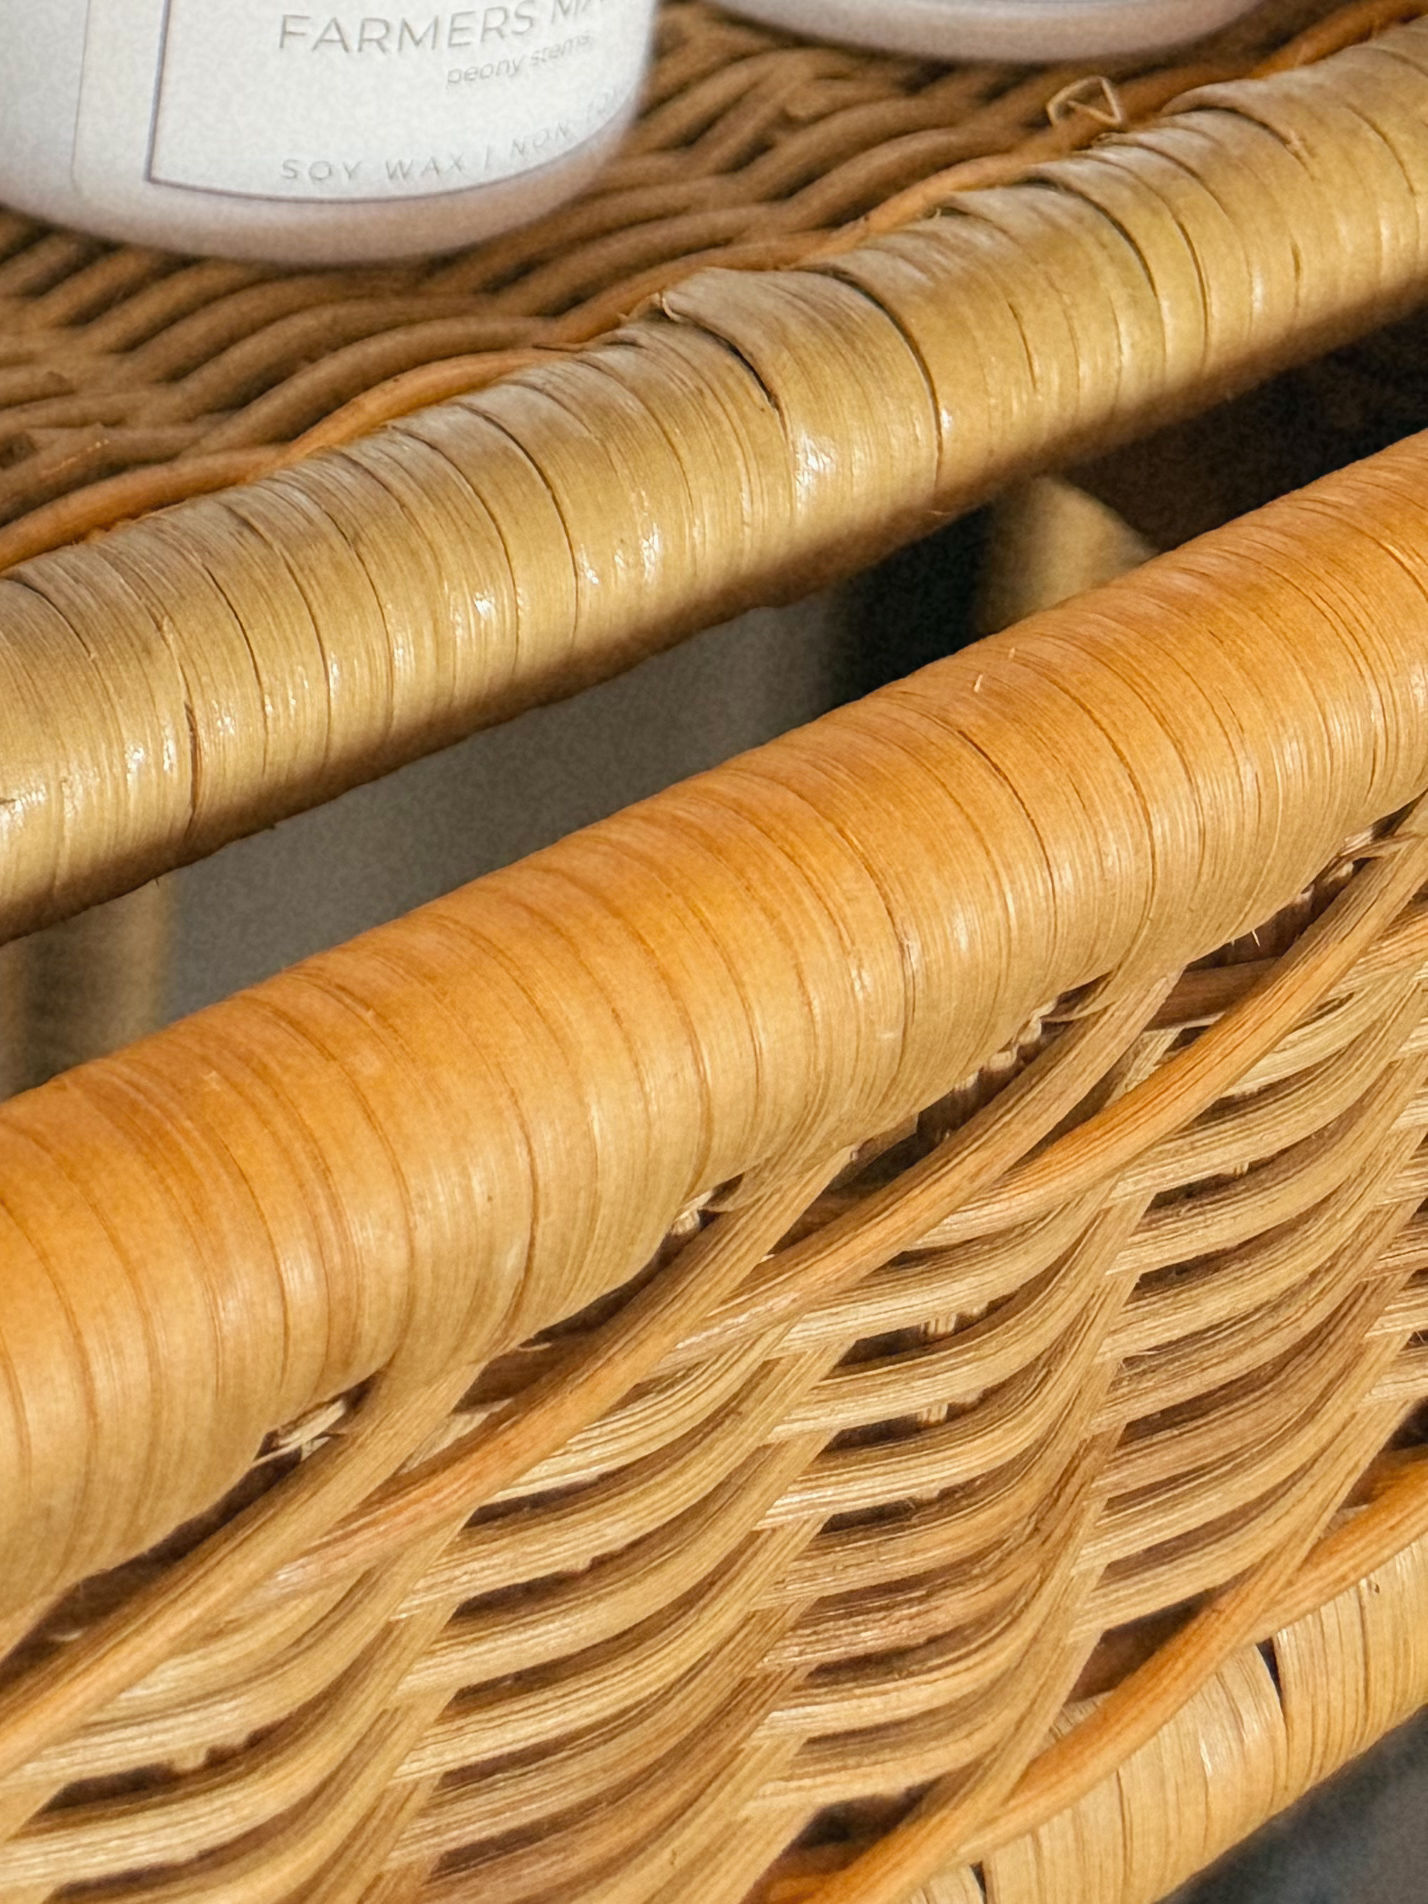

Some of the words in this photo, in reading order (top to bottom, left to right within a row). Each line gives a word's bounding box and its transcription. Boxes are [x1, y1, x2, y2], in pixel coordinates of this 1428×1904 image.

[446, 55, 523, 92] peony
[280, 158, 362, 182] SOY
[385, 152, 467, 181] WAX
